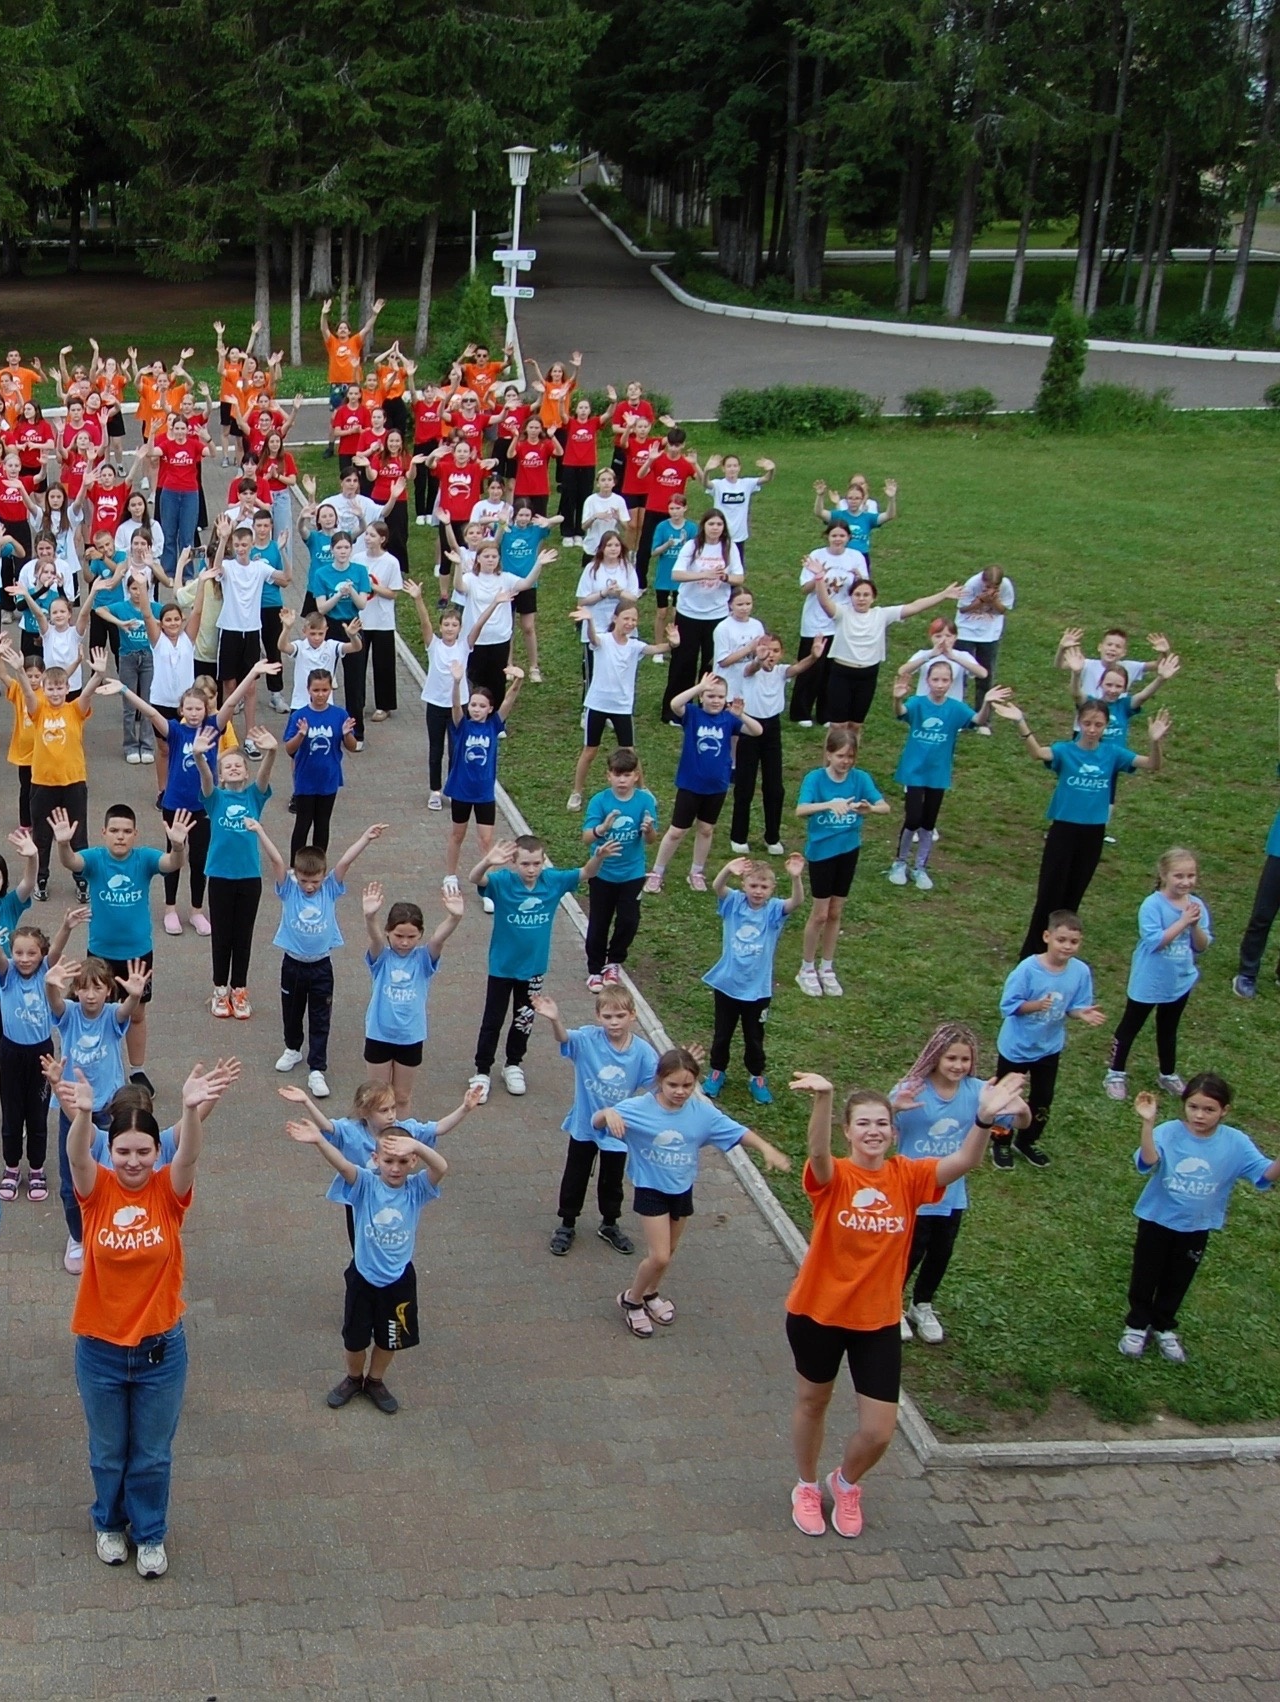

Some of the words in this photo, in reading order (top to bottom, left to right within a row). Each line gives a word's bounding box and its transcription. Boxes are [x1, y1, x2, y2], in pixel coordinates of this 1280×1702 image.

[912, 729, 949, 743] САХАРЕЖ
[1067, 776, 1109, 788] САХАРЕЖ
[99, 889, 143, 903] САХАРЕЖ
[507, 912, 550, 925] САХАРЕЖ
[837, 1210, 905, 1233] САХАРЕЖ
[98, 1225, 163, 1250] САХАРЕЖ
